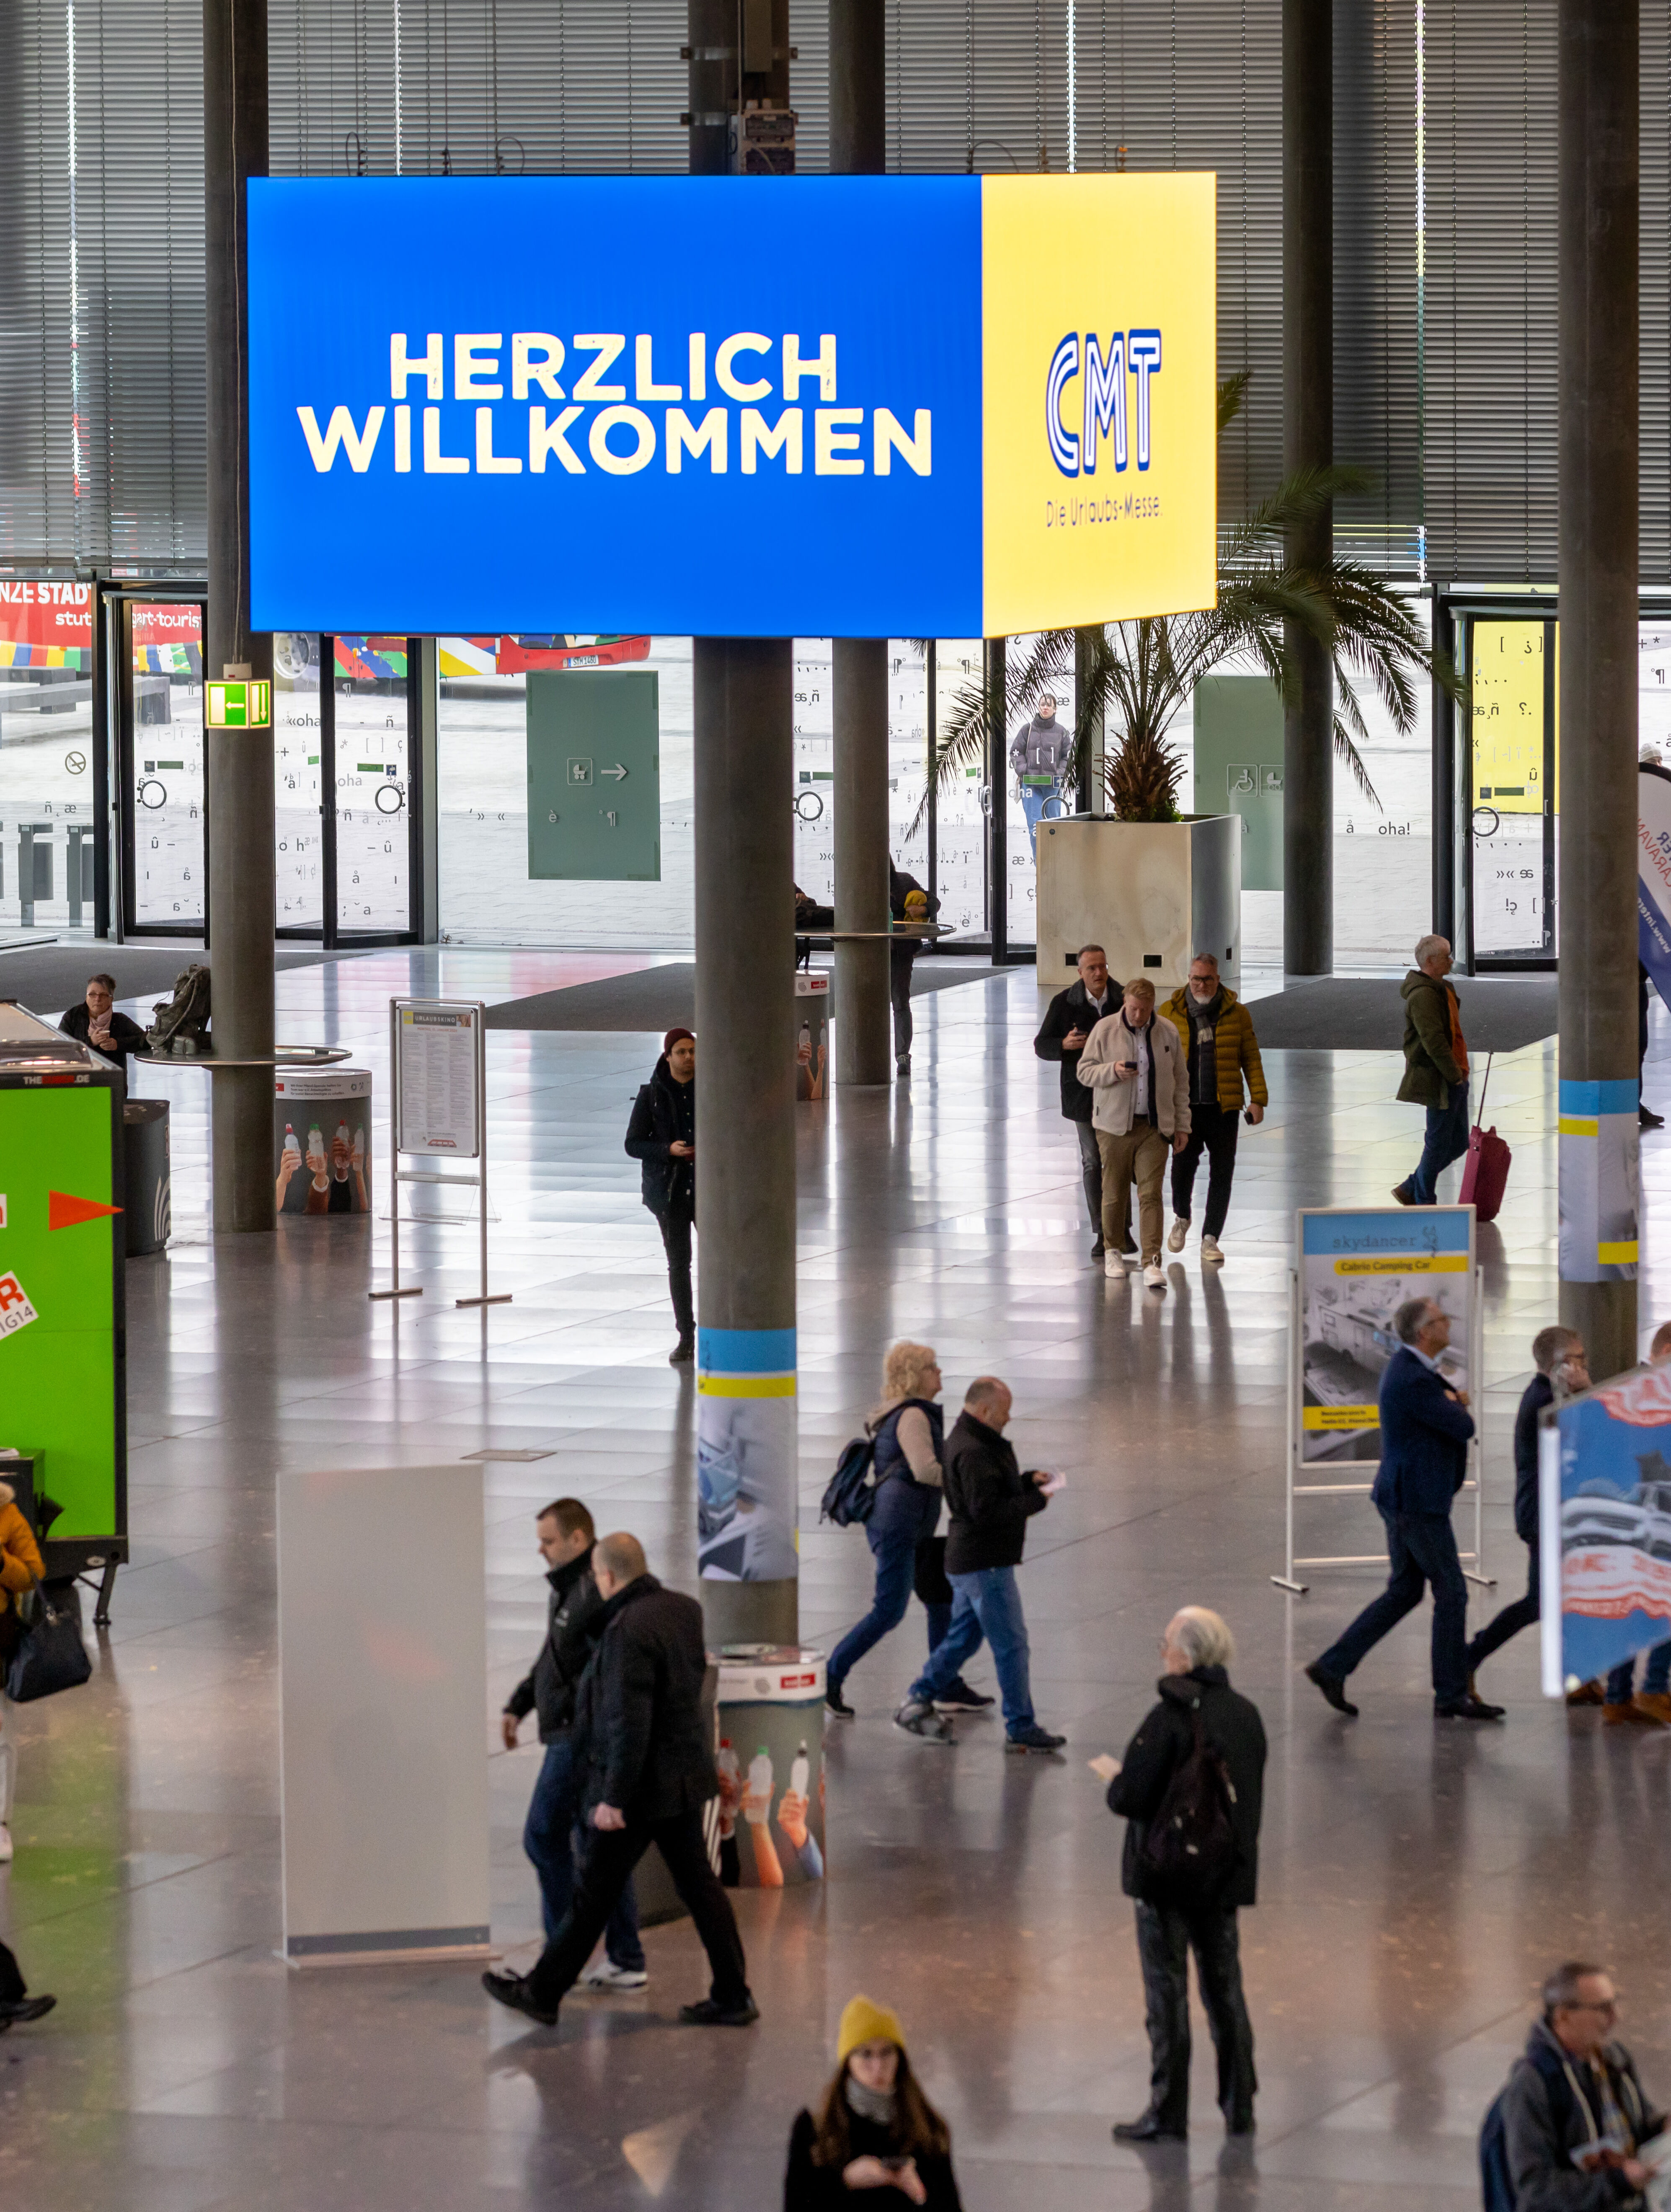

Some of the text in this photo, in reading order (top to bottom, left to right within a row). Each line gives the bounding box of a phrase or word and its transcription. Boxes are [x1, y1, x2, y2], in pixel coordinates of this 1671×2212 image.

[391, 332, 837, 401] HERZLICH
[1046, 329, 1161, 478] CMT
[297, 405, 932, 476] WILLKOMMEN
[1047, 498, 1066, 528] Die
[1379, 821, 1410, 835] oha!
[1333, 1234, 1416, 1251] skydancer
[1372, 1261, 1413, 1272] Camping
